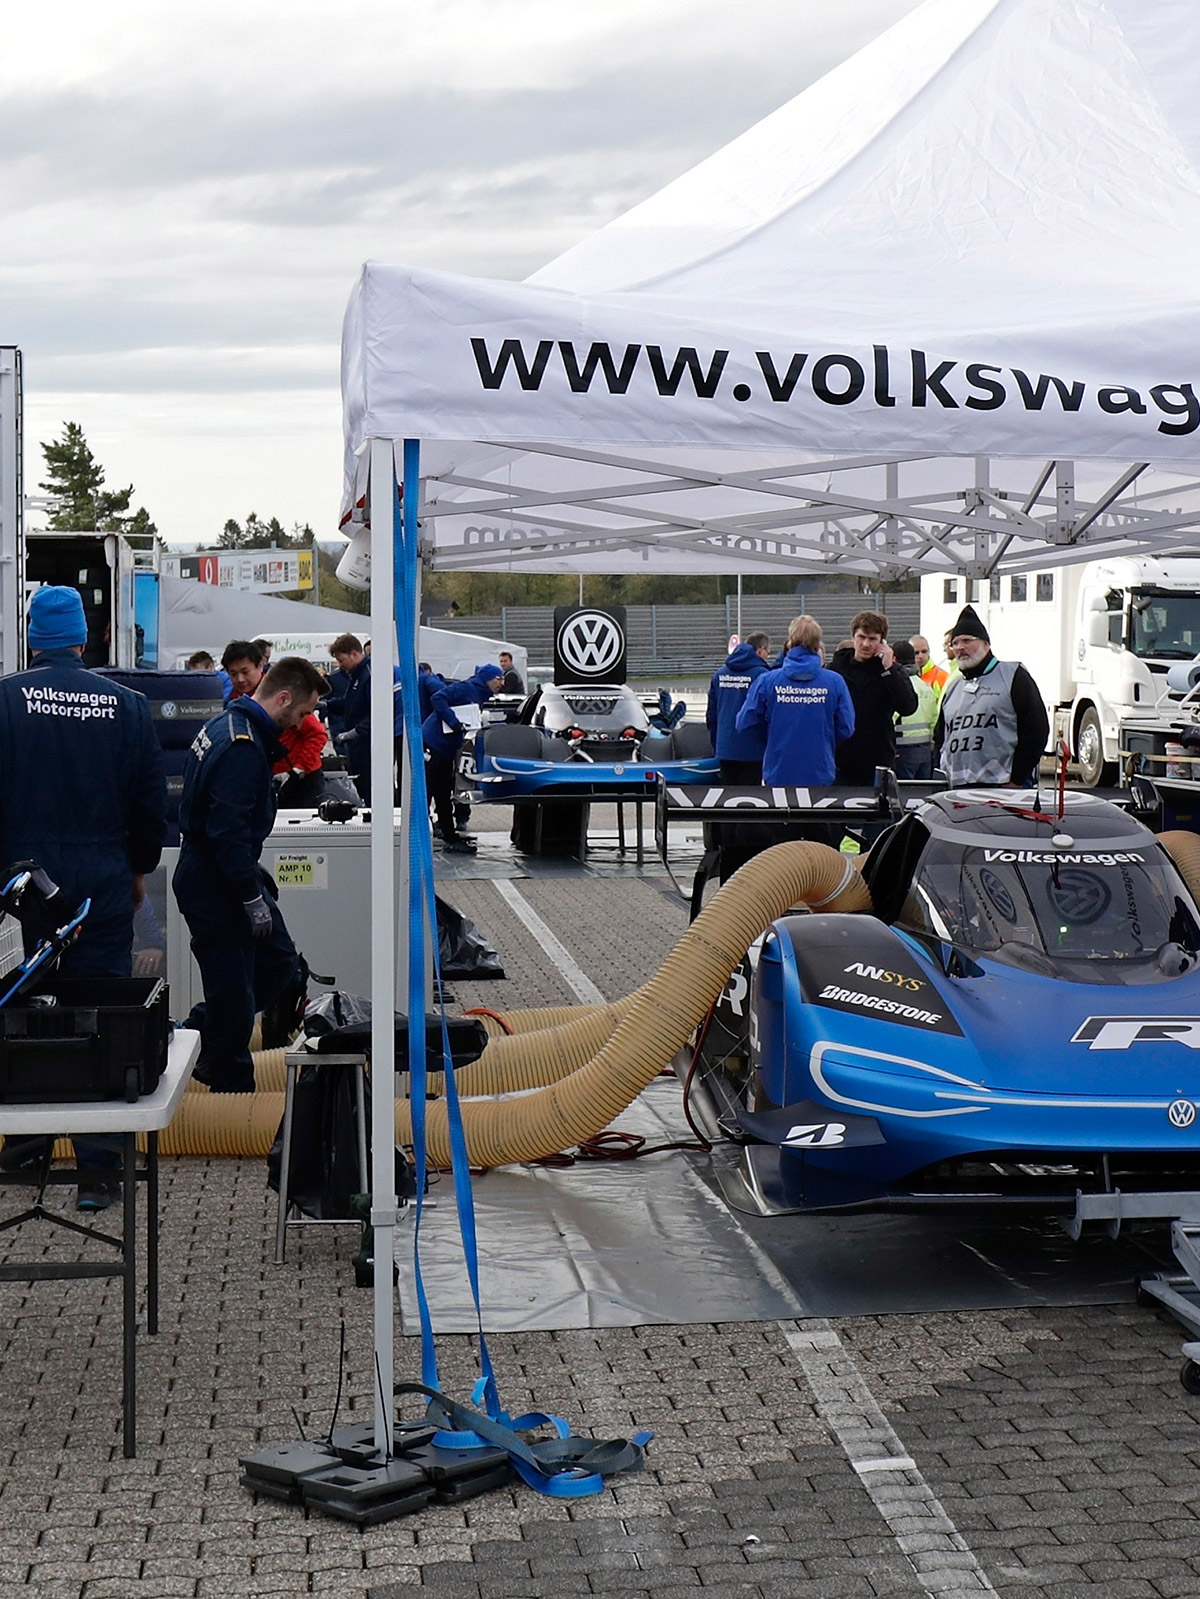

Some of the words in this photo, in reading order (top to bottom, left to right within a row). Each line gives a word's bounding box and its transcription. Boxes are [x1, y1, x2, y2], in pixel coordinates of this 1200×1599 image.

[719, 674, 751, 684] Volkswagen
[719, 681, 749, 689] Motorsport
[21, 687, 118, 706] Volkswagen
[774, 685, 828, 696] Volkswagen
[776, 694, 826, 704] Motorsport
[26, 700, 115, 721] Motorsport
[946, 712, 999, 734] MEDIA
[949, 735, 985, 754] 013
[667, 787, 921, 809] Volks
[984, 850, 1146, 866] Volkswagen
[279, 864, 299, 872] AMP
[302, 864, 312, 872] 10
[844, 962, 926, 992] ANSYS
[818, 985, 943, 1025] BRIDGESTONE
